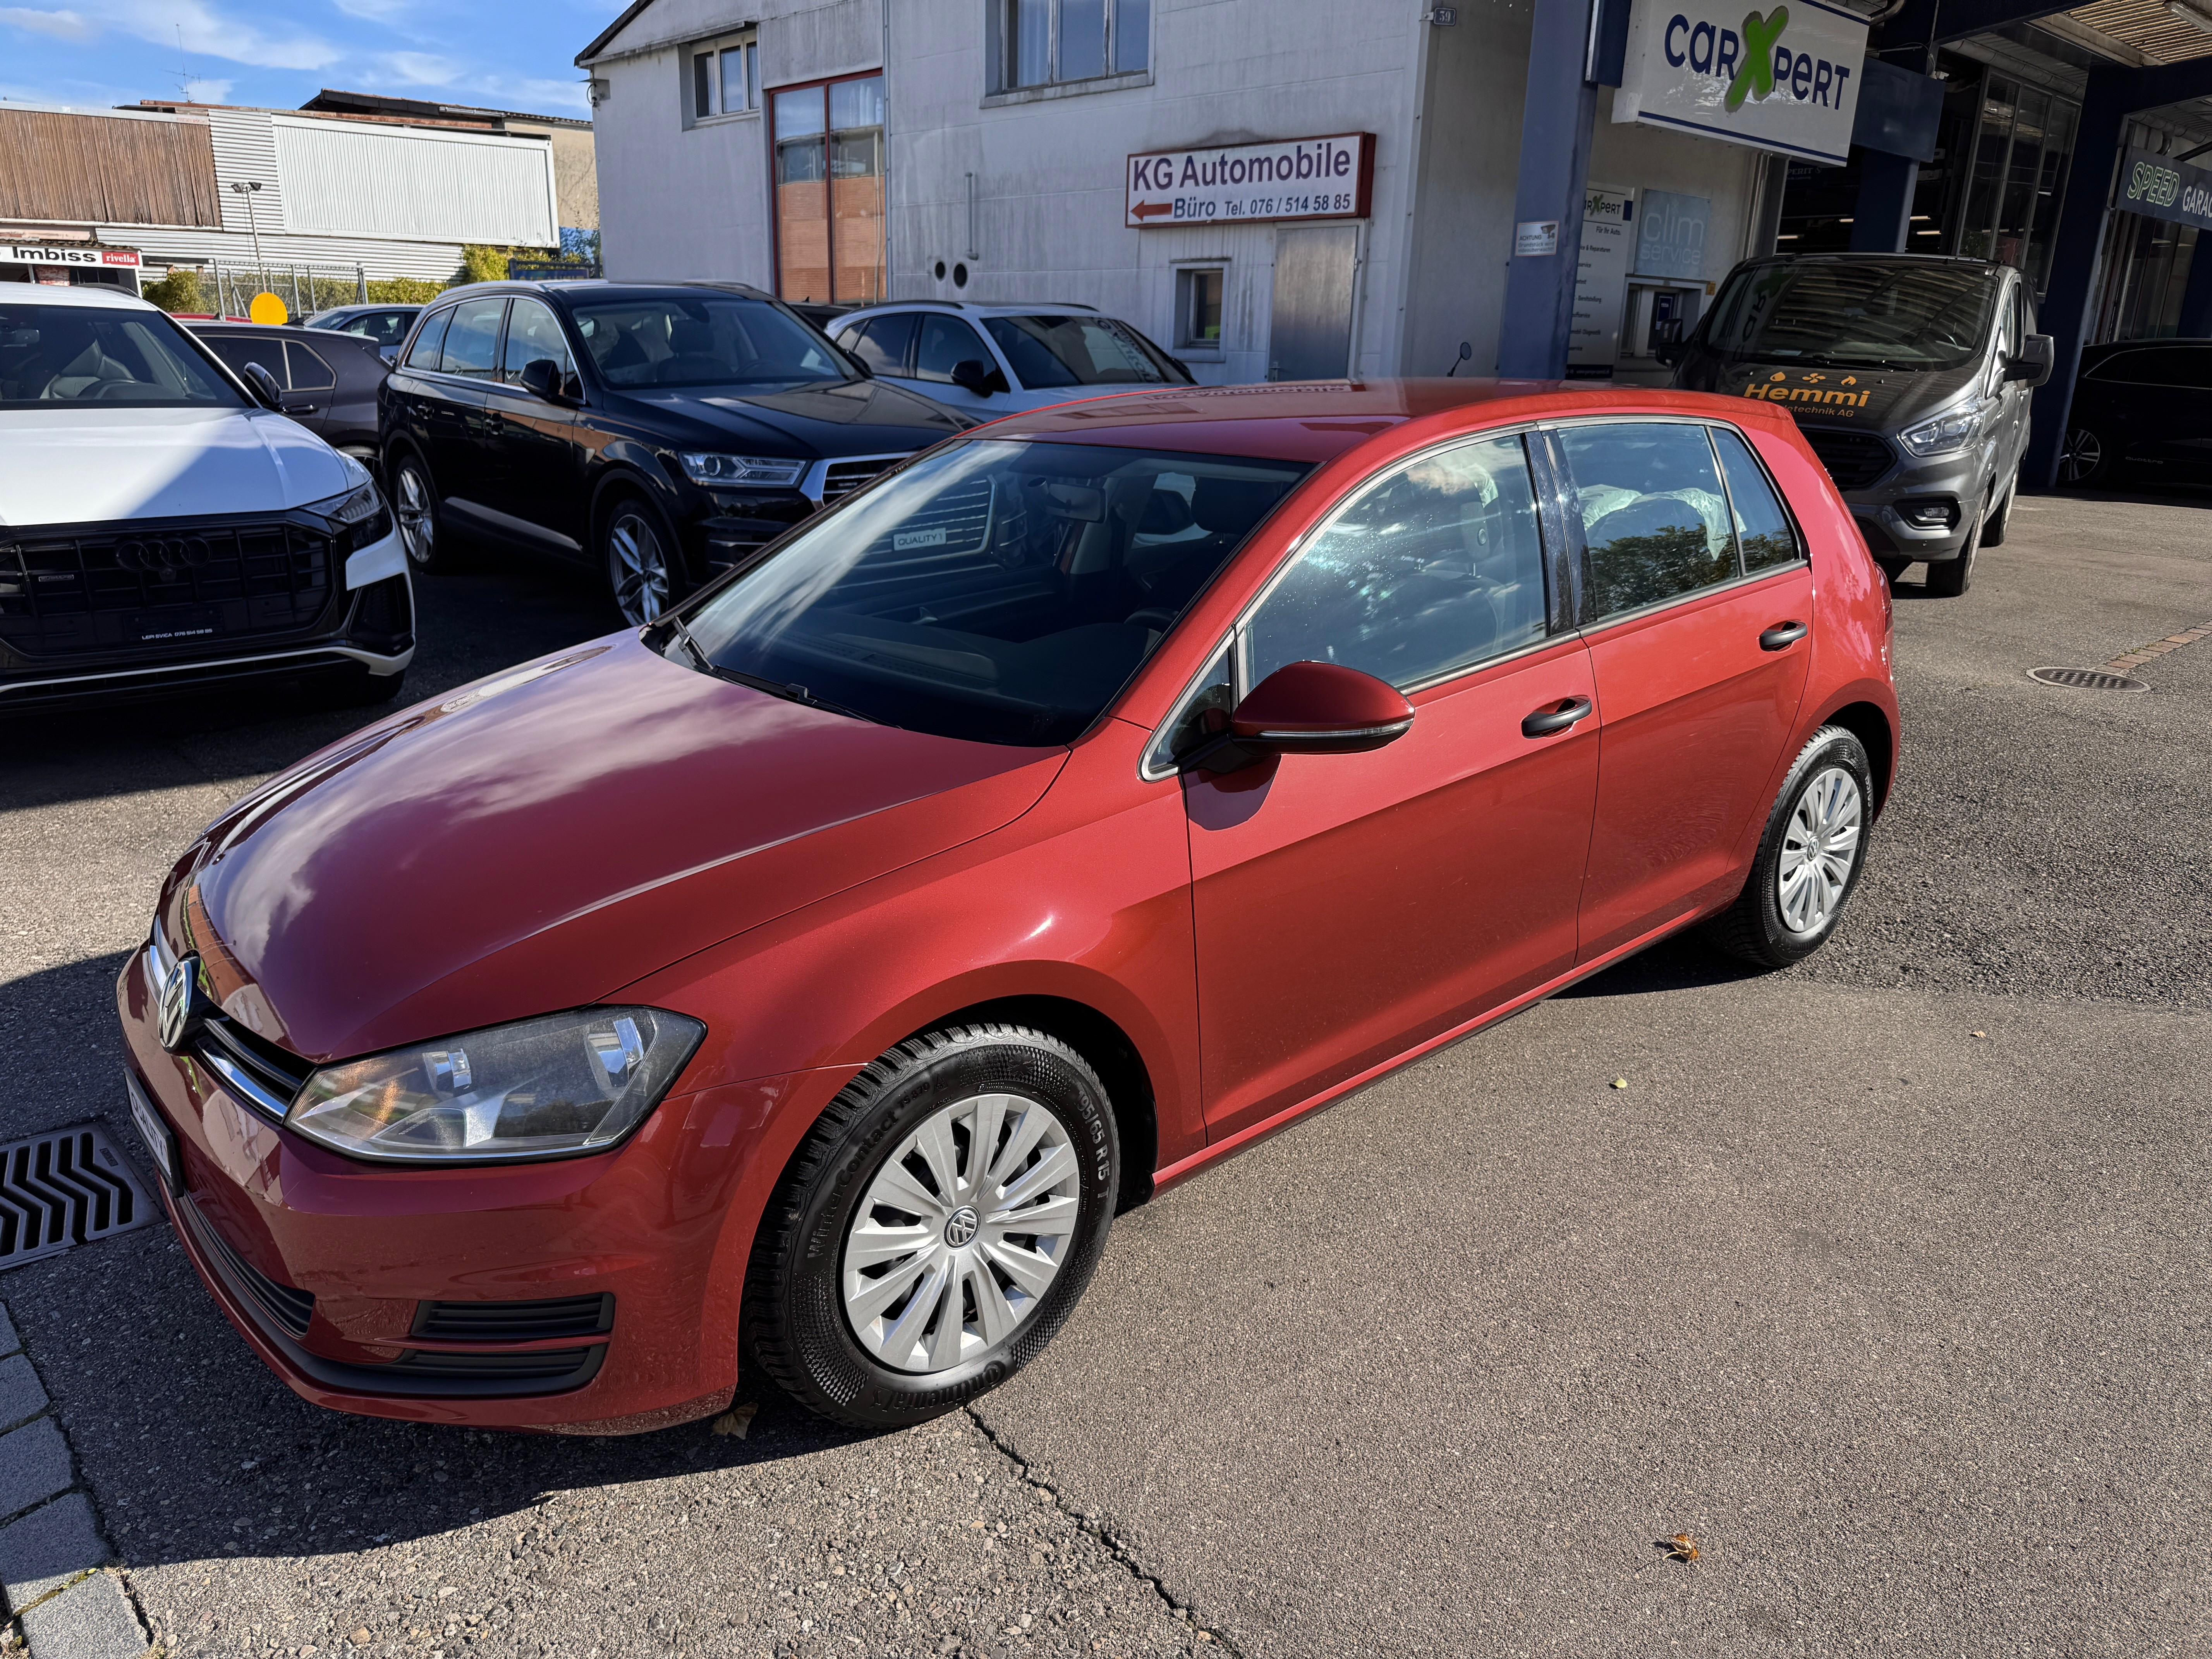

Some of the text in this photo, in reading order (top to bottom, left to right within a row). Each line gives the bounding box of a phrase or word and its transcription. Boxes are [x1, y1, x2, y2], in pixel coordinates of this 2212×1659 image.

[1133, 142, 1351, 191] KG Automobile
[2127, 161, 2180, 207] SPEED
[1173, 197, 1216, 219] Büro
[1224, 201, 1245, 216] Tel.
[1250, 198, 1273, 215] 076
[1285, 196, 1309, 213] 514
[1313, 194, 1329, 211] 58
[1334, 194, 1350, 210] 85
[1644, 203, 1704, 247] clim
[12, 246, 135, 263] Imbiss rivella
[1640, 244, 1701, 264] service
[1743, 384, 1870, 407] Hemmi
[1837, 409, 1854, 417] AG
[898, 534, 937, 546] QUALITY
[807, 1110, 898, 1259] WinterContact
